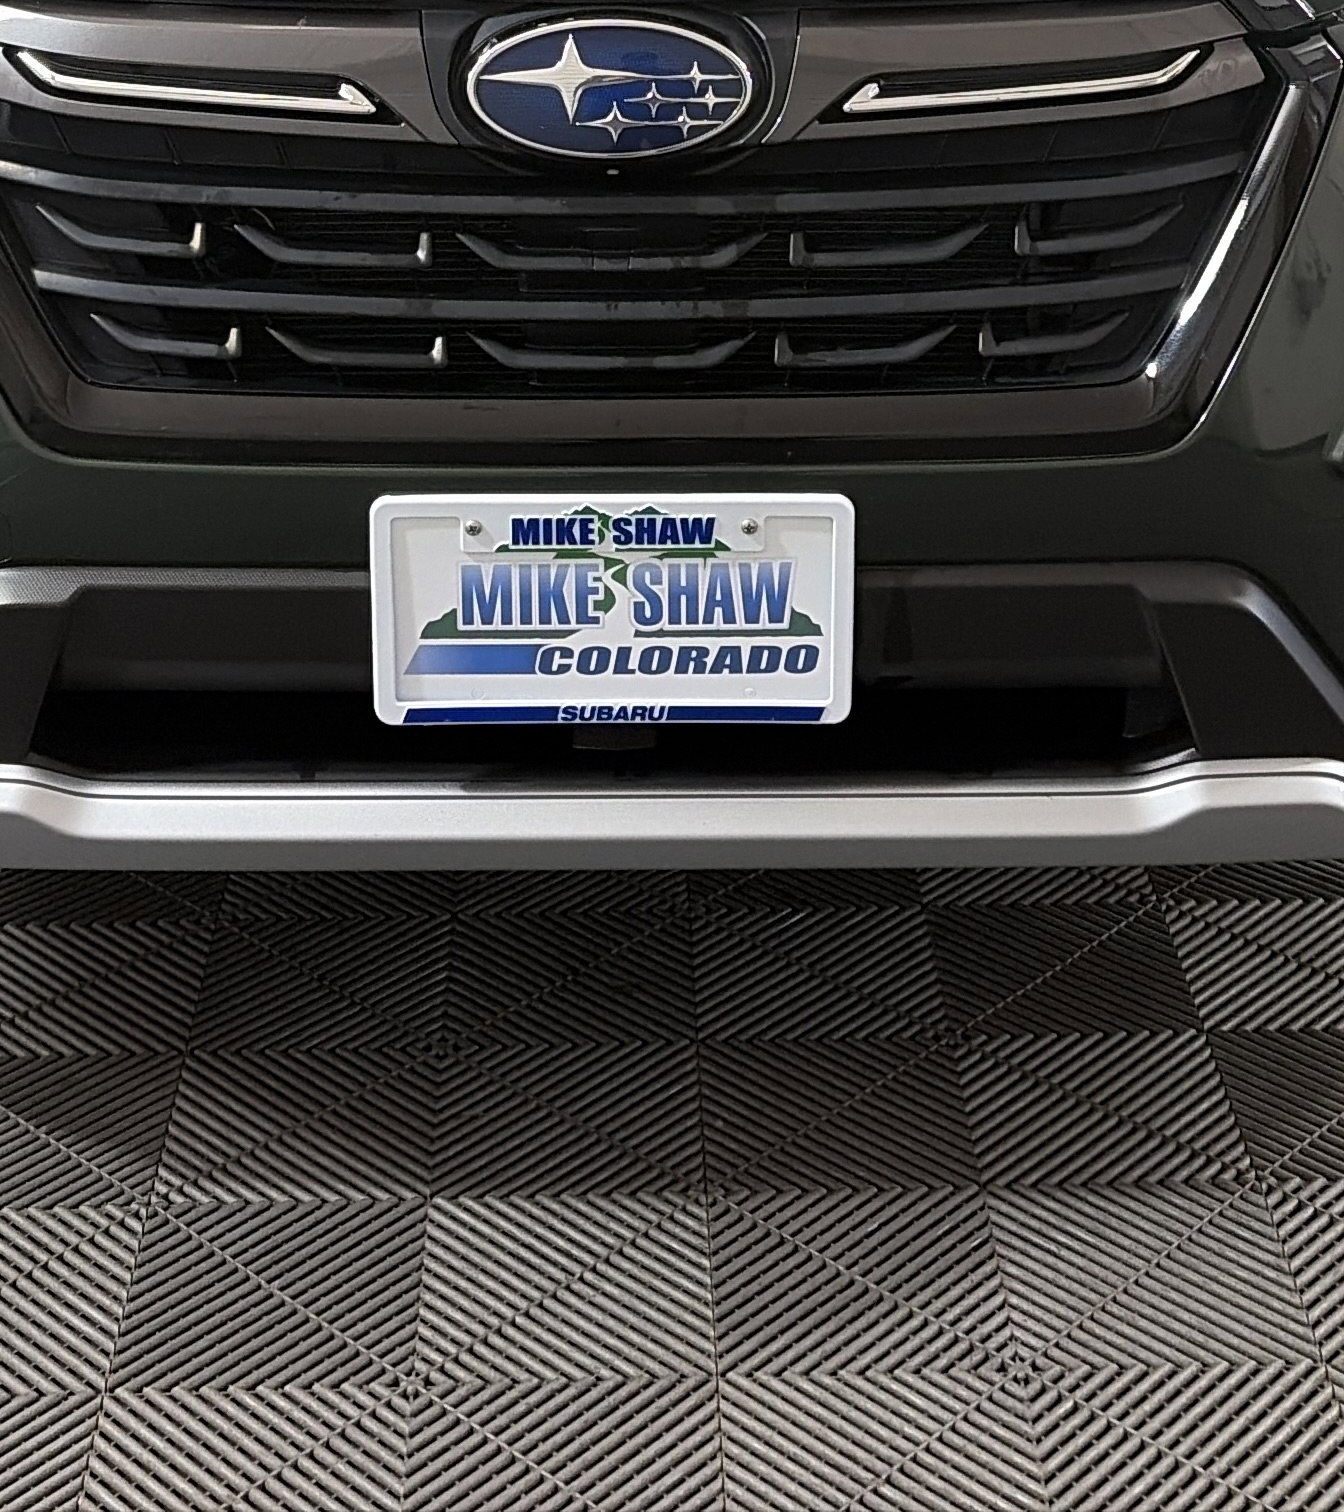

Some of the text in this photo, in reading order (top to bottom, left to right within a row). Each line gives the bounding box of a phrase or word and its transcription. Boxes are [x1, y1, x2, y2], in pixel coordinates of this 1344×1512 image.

[511, 517, 716, 546] MIKE SHAW
[460, 560, 794, 626] MIKE SHAW
[538, 644, 821, 676] COLORADO
[560, 705, 666, 722] SUBARU
